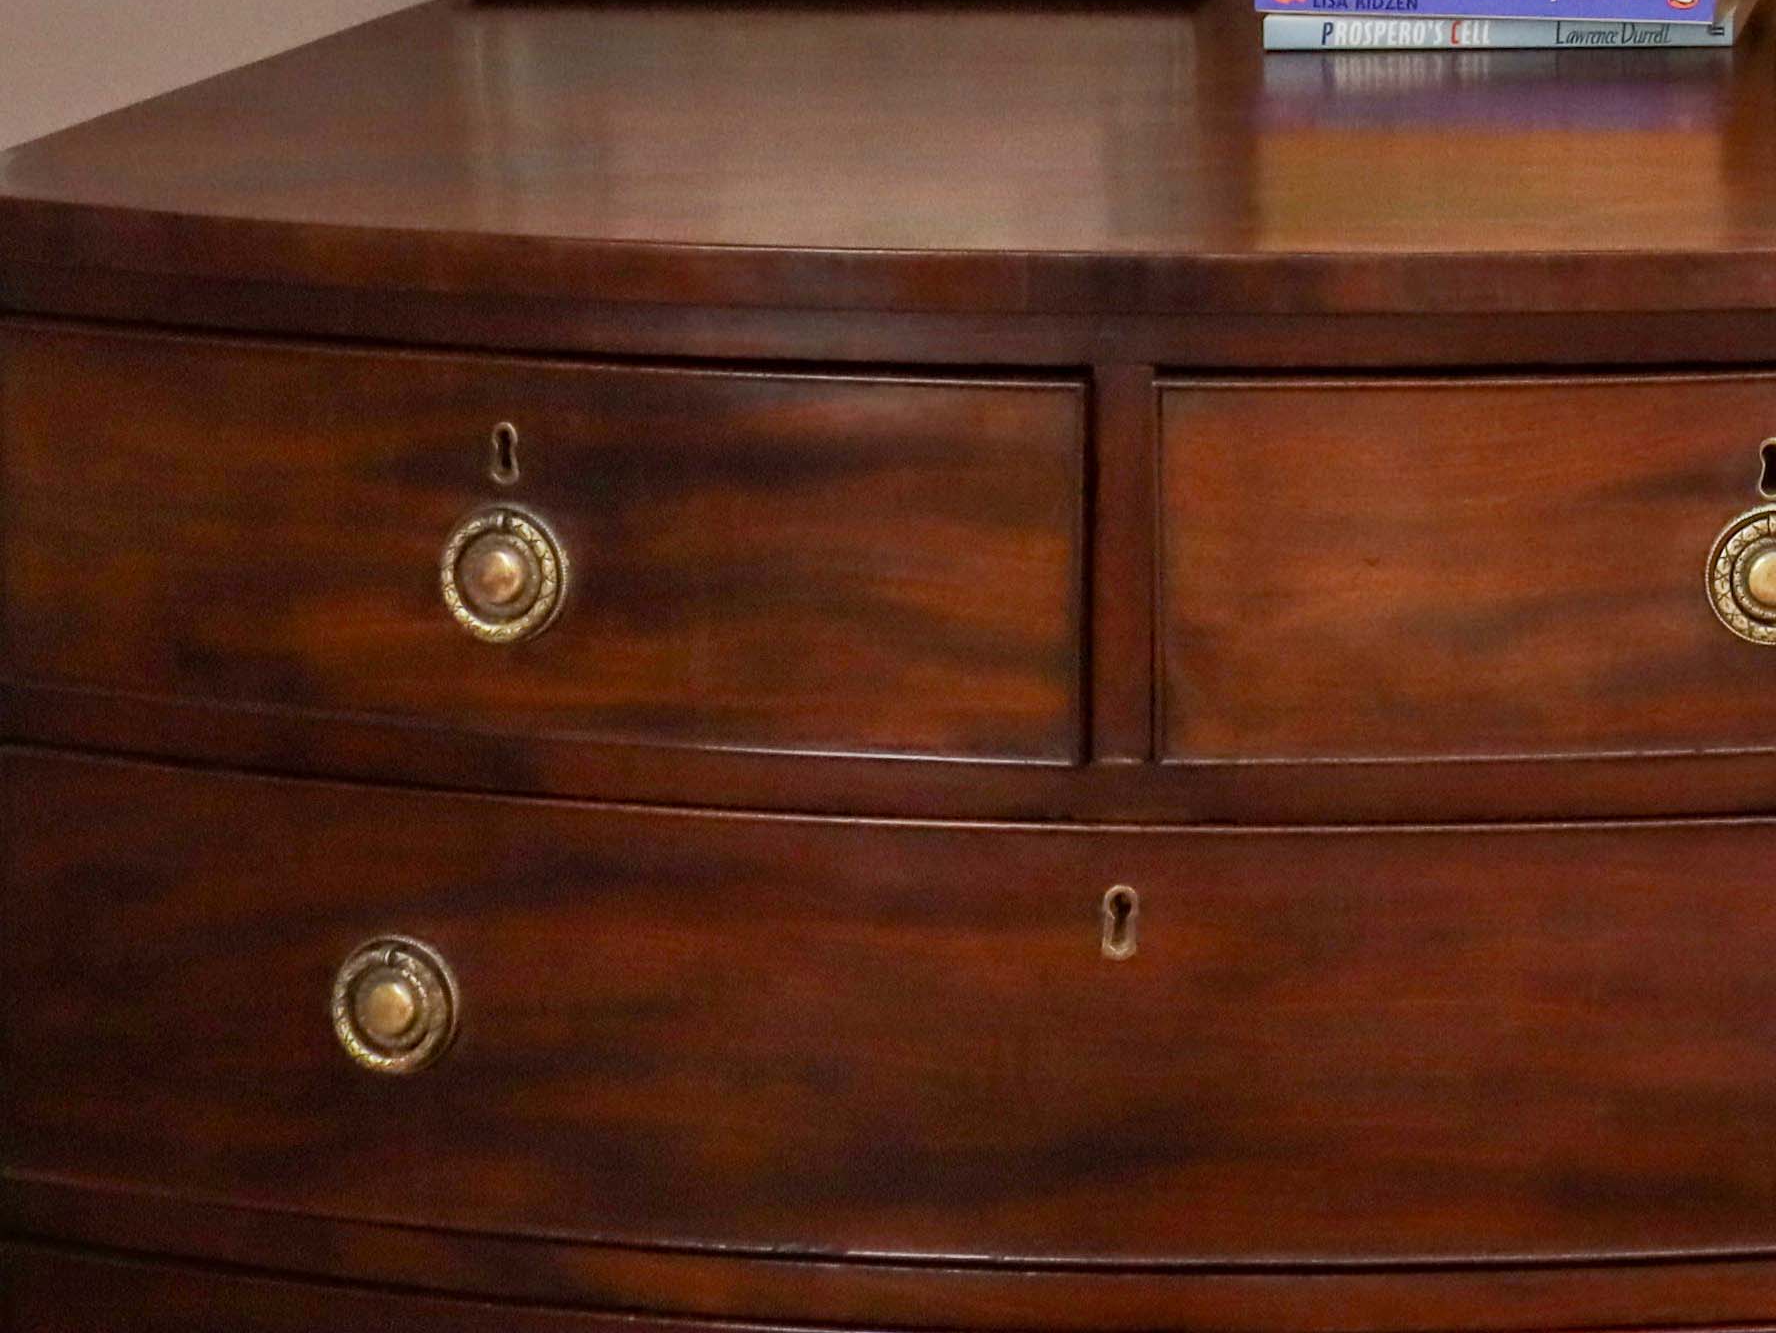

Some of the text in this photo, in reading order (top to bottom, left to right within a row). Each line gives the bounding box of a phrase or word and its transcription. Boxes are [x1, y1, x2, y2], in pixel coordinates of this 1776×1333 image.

[1321, 20, 1671, 46] PROSPERO'S CELL Lawrence Durrell
